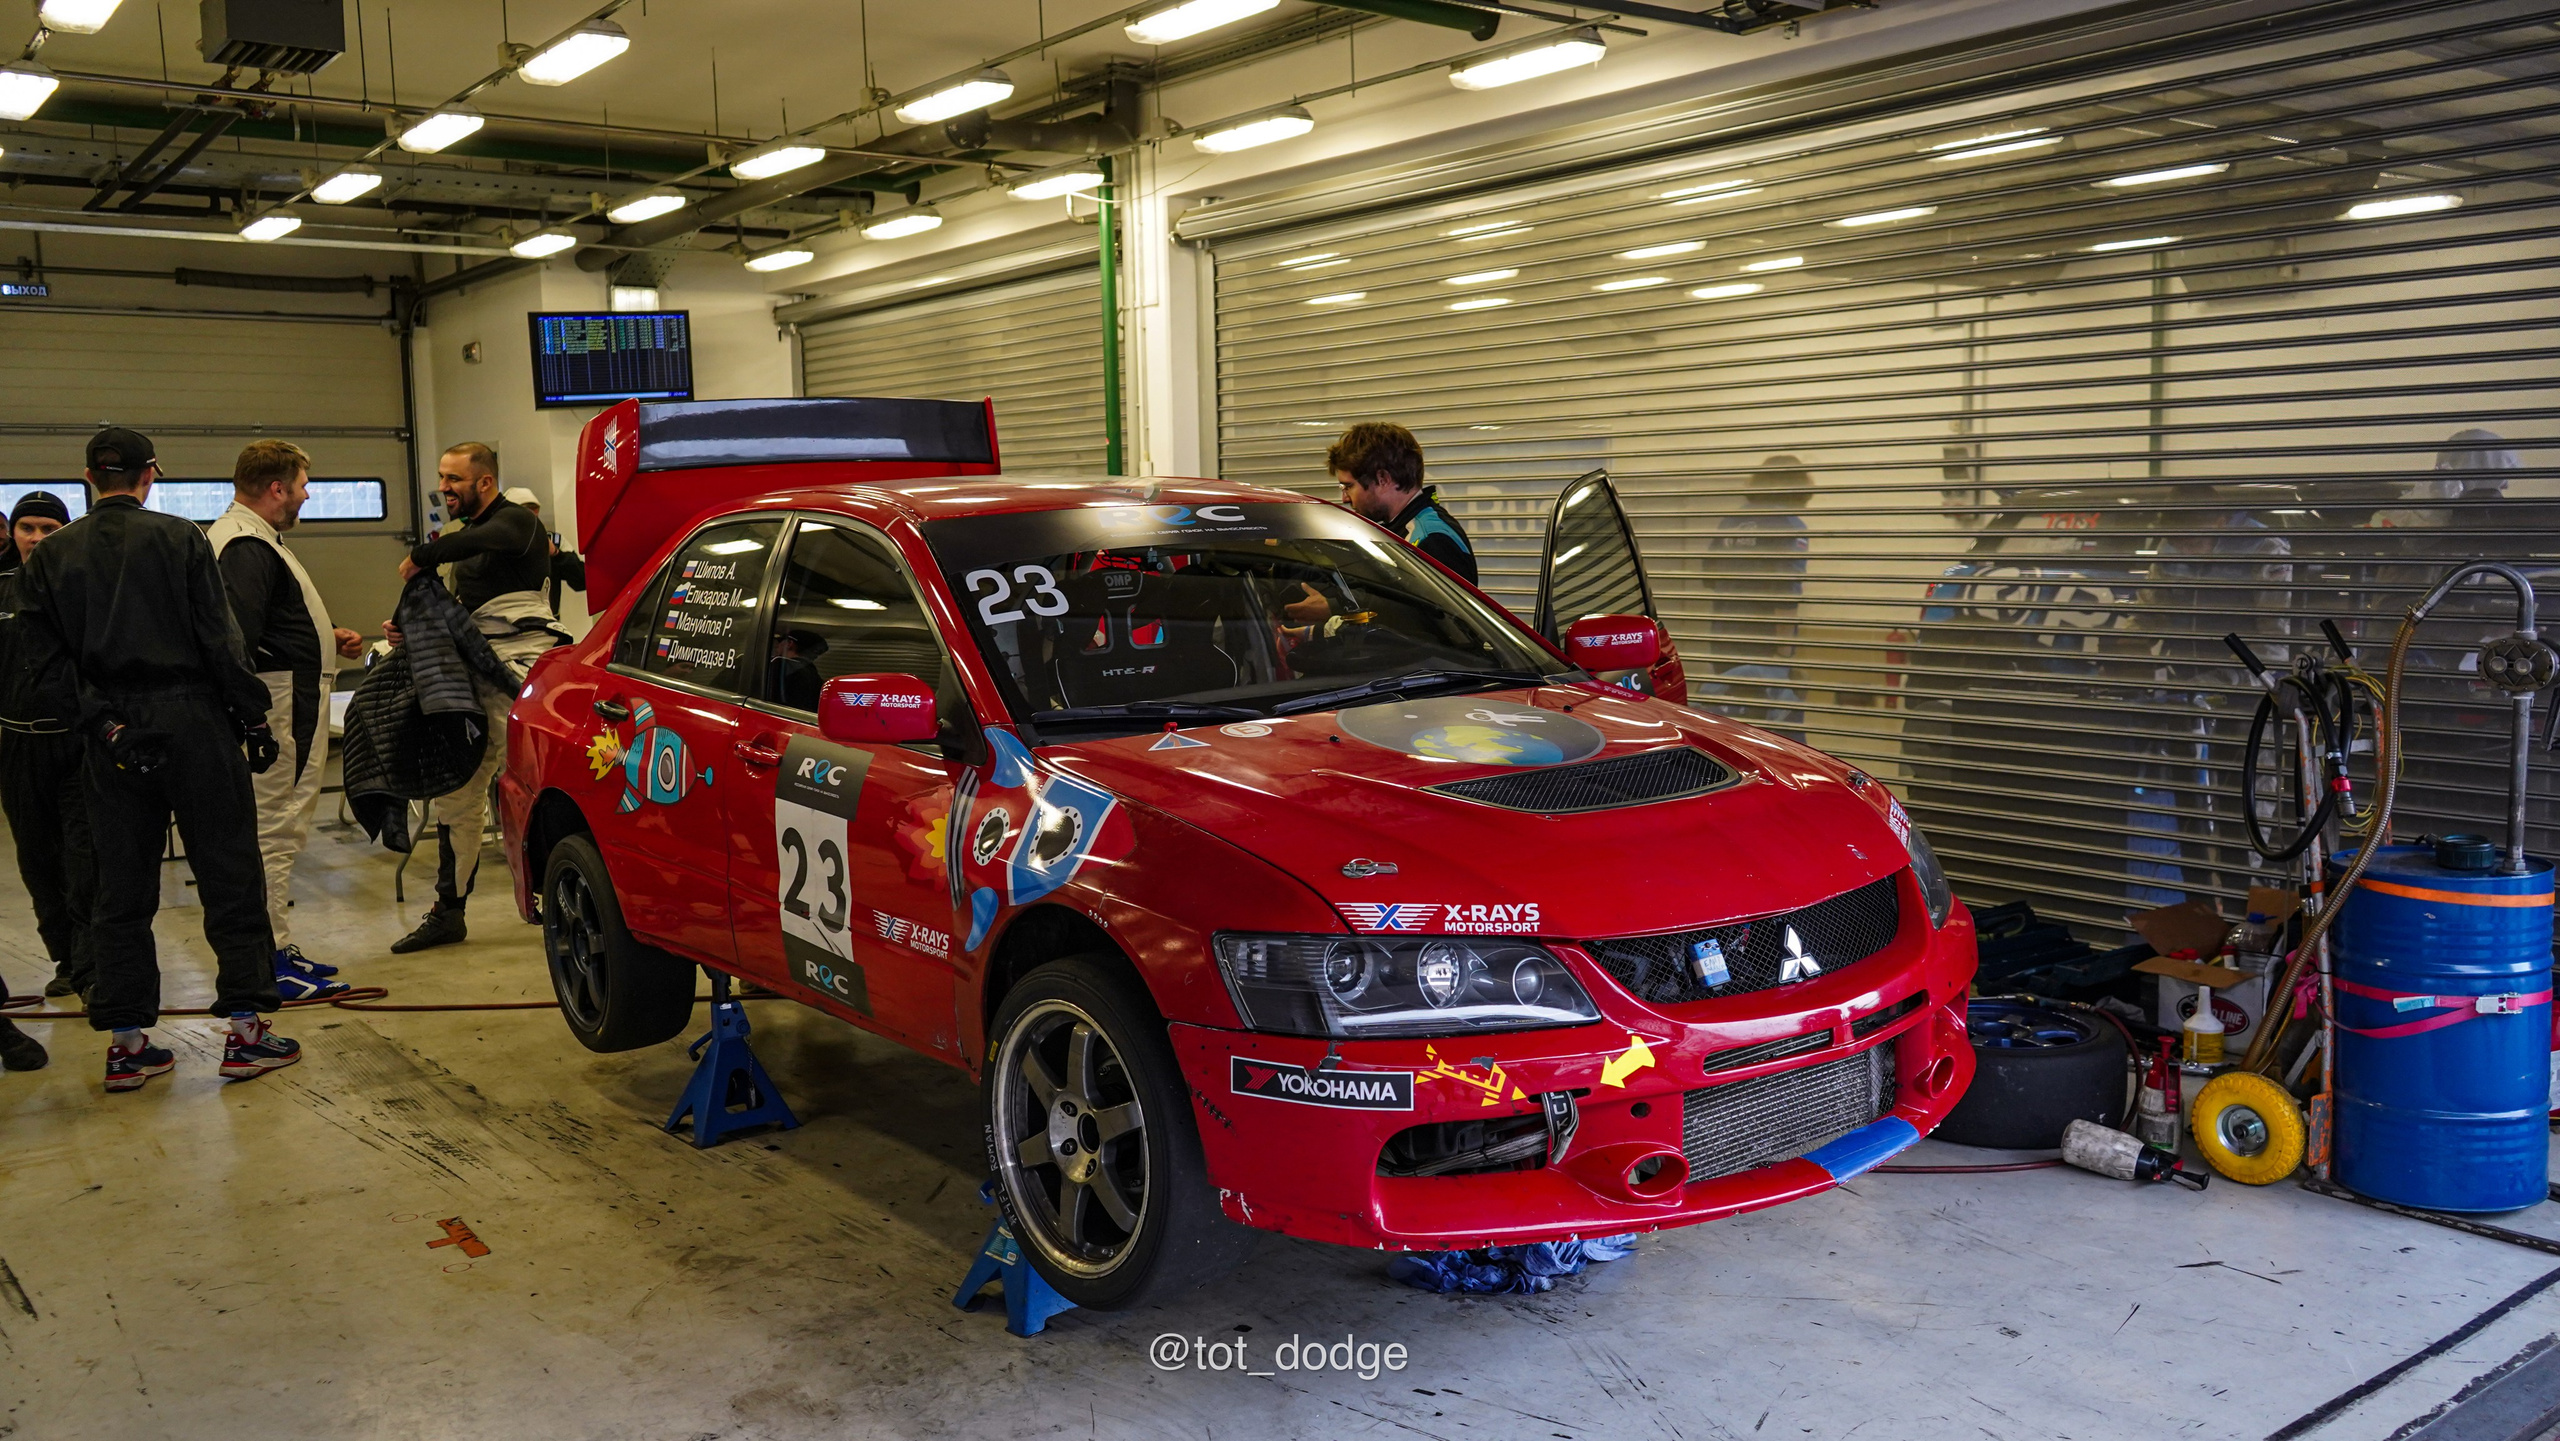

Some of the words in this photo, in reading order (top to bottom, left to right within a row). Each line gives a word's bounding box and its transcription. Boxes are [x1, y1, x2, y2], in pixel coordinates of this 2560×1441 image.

[2, 284, 48, 297] ВЫХОД
[694, 560, 727, 579] Шипов
[725, 561, 737, 580] А.
[1104, 574, 1132, 587] OMP
[685, 585, 730, 610] Елизаров
[729, 588, 743, 608] М.
[965, 564, 1070, 626] 23
[676, 611, 722, 637] Мануйлов
[722, 617, 733, 638] Р.
[1611, 632, 1643, 642] X-RAYS
[667, 640, 725, 669] Димитрадзе
[726, 648, 736, 669] В.
[1102, 665, 1156, 677] HTE-R
[881, 693, 922, 704] X-RAYS
[781, 827, 847, 934] 23
[1444, 903, 1539, 922] X-RAYS
[910, 923, 950, 950] X-RAYS
[1444, 921, 1540, 933] MOTORSPORT
[910, 940, 949, 960] MOTORSPORT
[2219, 1009, 2244, 1026] LINE
[1277, 1072, 1398, 1102] YOKOHAMA
[985, 1124, 999, 1172] ROMAN
